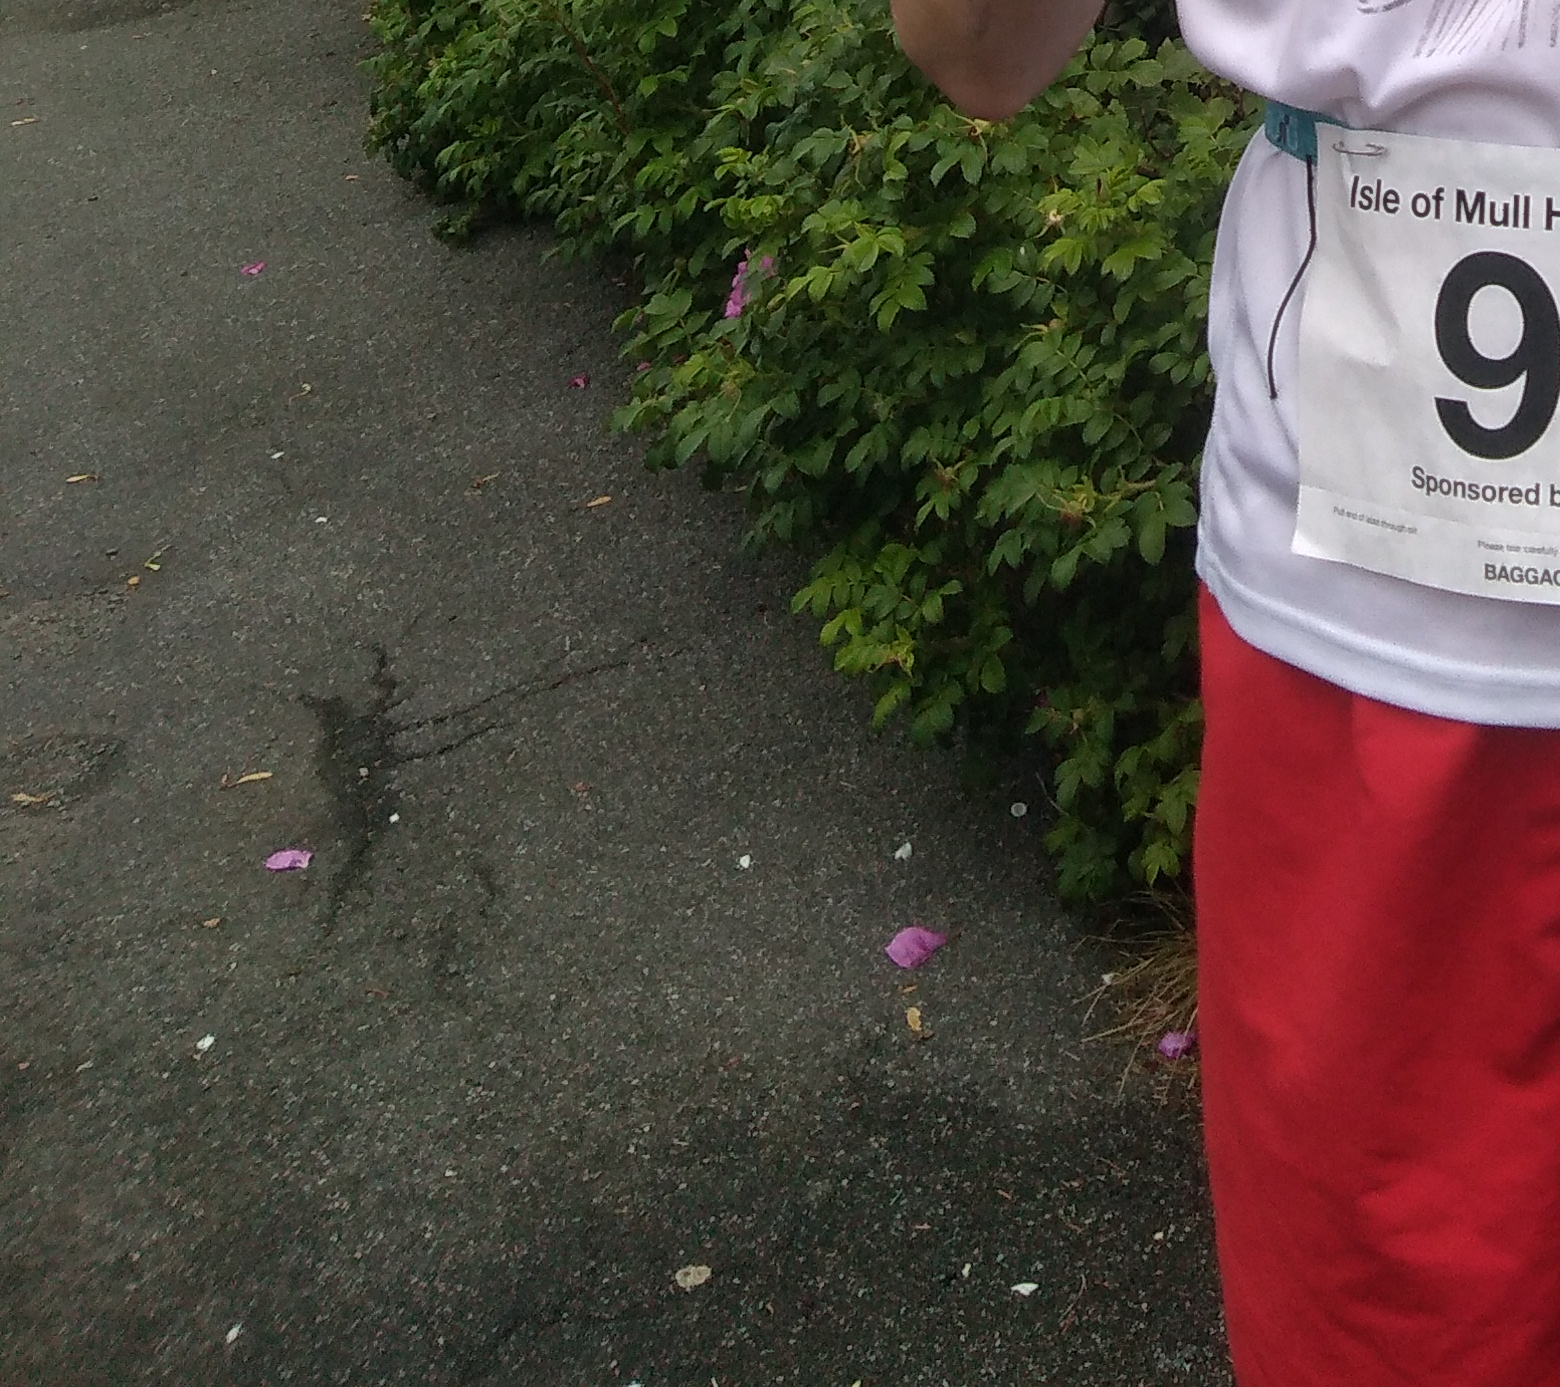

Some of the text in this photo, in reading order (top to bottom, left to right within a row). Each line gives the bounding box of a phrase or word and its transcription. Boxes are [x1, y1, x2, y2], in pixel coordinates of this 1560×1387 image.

[1350, 175, 1401, 215] Isle
[1411, 187, 1445, 220] of
[1455, 188, 1531, 229] Mull
[1411, 465, 1541, 506] Sponsored
